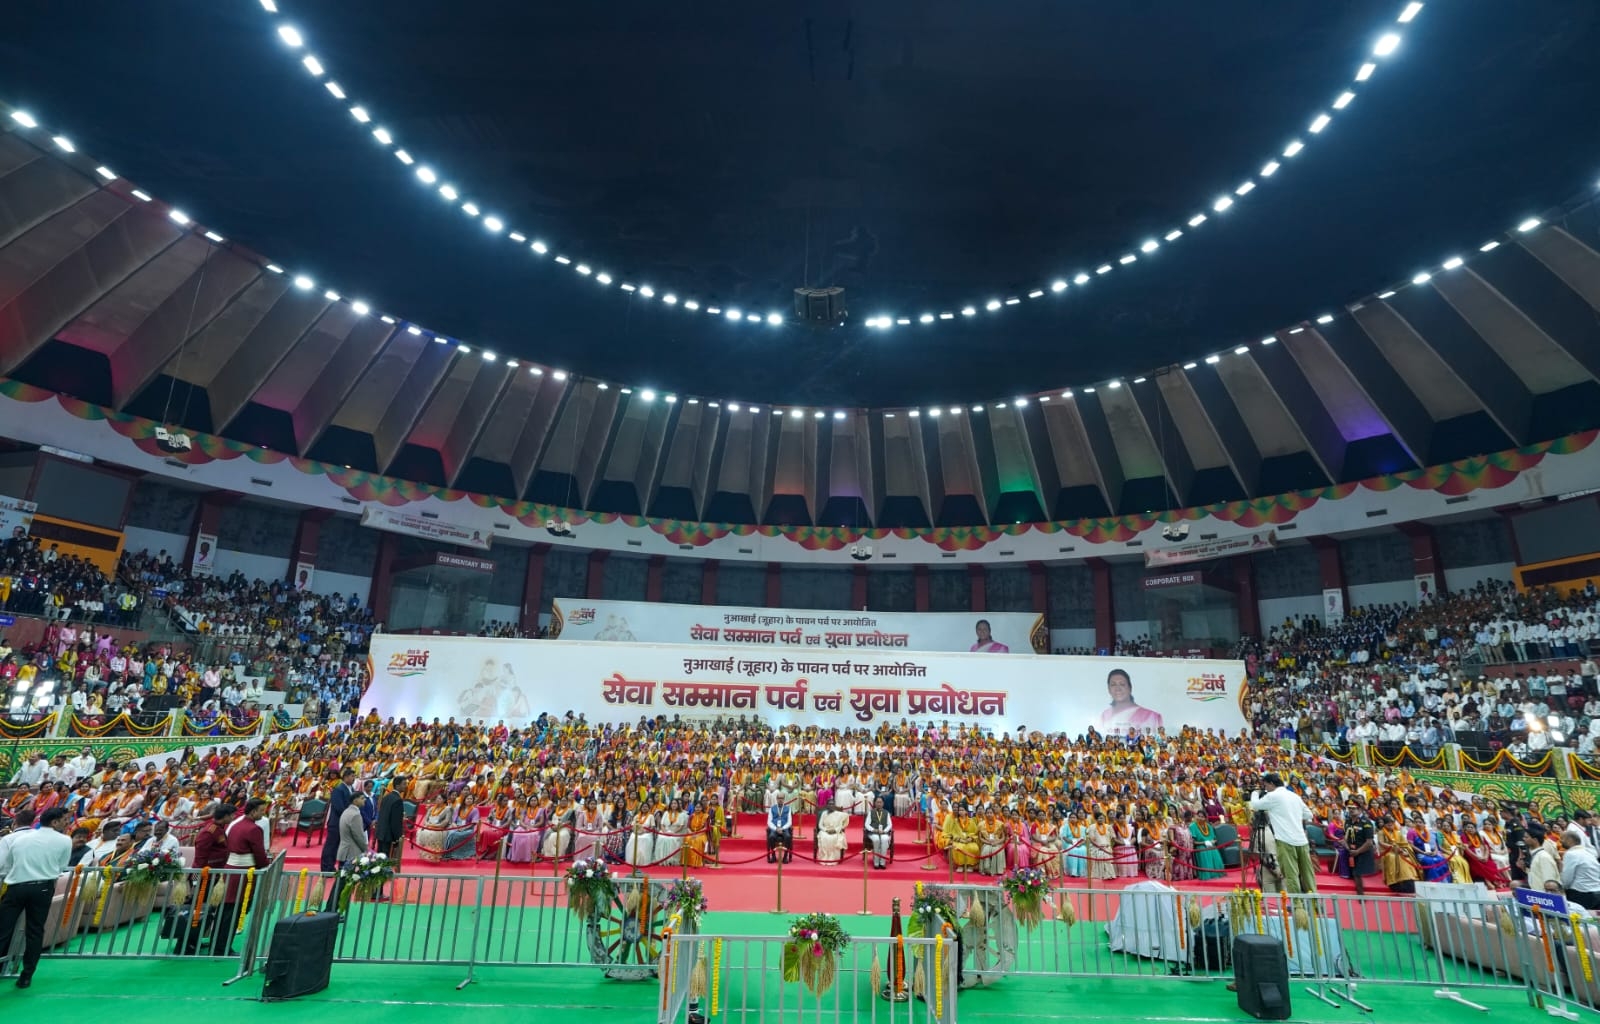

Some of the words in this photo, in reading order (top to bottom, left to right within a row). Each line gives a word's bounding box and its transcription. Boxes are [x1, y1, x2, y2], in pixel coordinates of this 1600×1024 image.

[724, 613, 756, 624] नुआखाई
[758, 615, 784, 626] (जूहार)
[786, 615, 794, 624] के
[796, 617, 815, 625] पावन
[818, 616, 829, 625] पर्व
[831, 618, 841, 626] पर
[842, 617, 877, 626] आयोजित
[690, 624, 720, 641] सेवा
[723, 628, 776, 644] सम्मान
[779, 627, 802, 645] पर्व
[805, 634, 821, 645] एवं
[825, 631, 853, 648] युवा
[855, 630, 909, 647] प्रबोधन
[683, 656, 734, 674] नुआखाई
[737, 660, 778, 676] (जूहार)
[781, 658, 794, 673] के
[797, 662, 829, 674] पावन
[832, 660, 851, 675] पर्व
[854, 664, 870, 676] पर
[872, 661, 927, 677] आयोजित
[602, 673, 657, 704] सेवा
[662, 682, 760, 709] सम्मान
[765, 678, 808, 710] पर्व
[813, 692, 842, 711] एवं
[850, 688, 901, 722] युवा
[907, 683, 1006, 716] प्रबोधन
[1526, 894, 1555, 907] SENIOR
